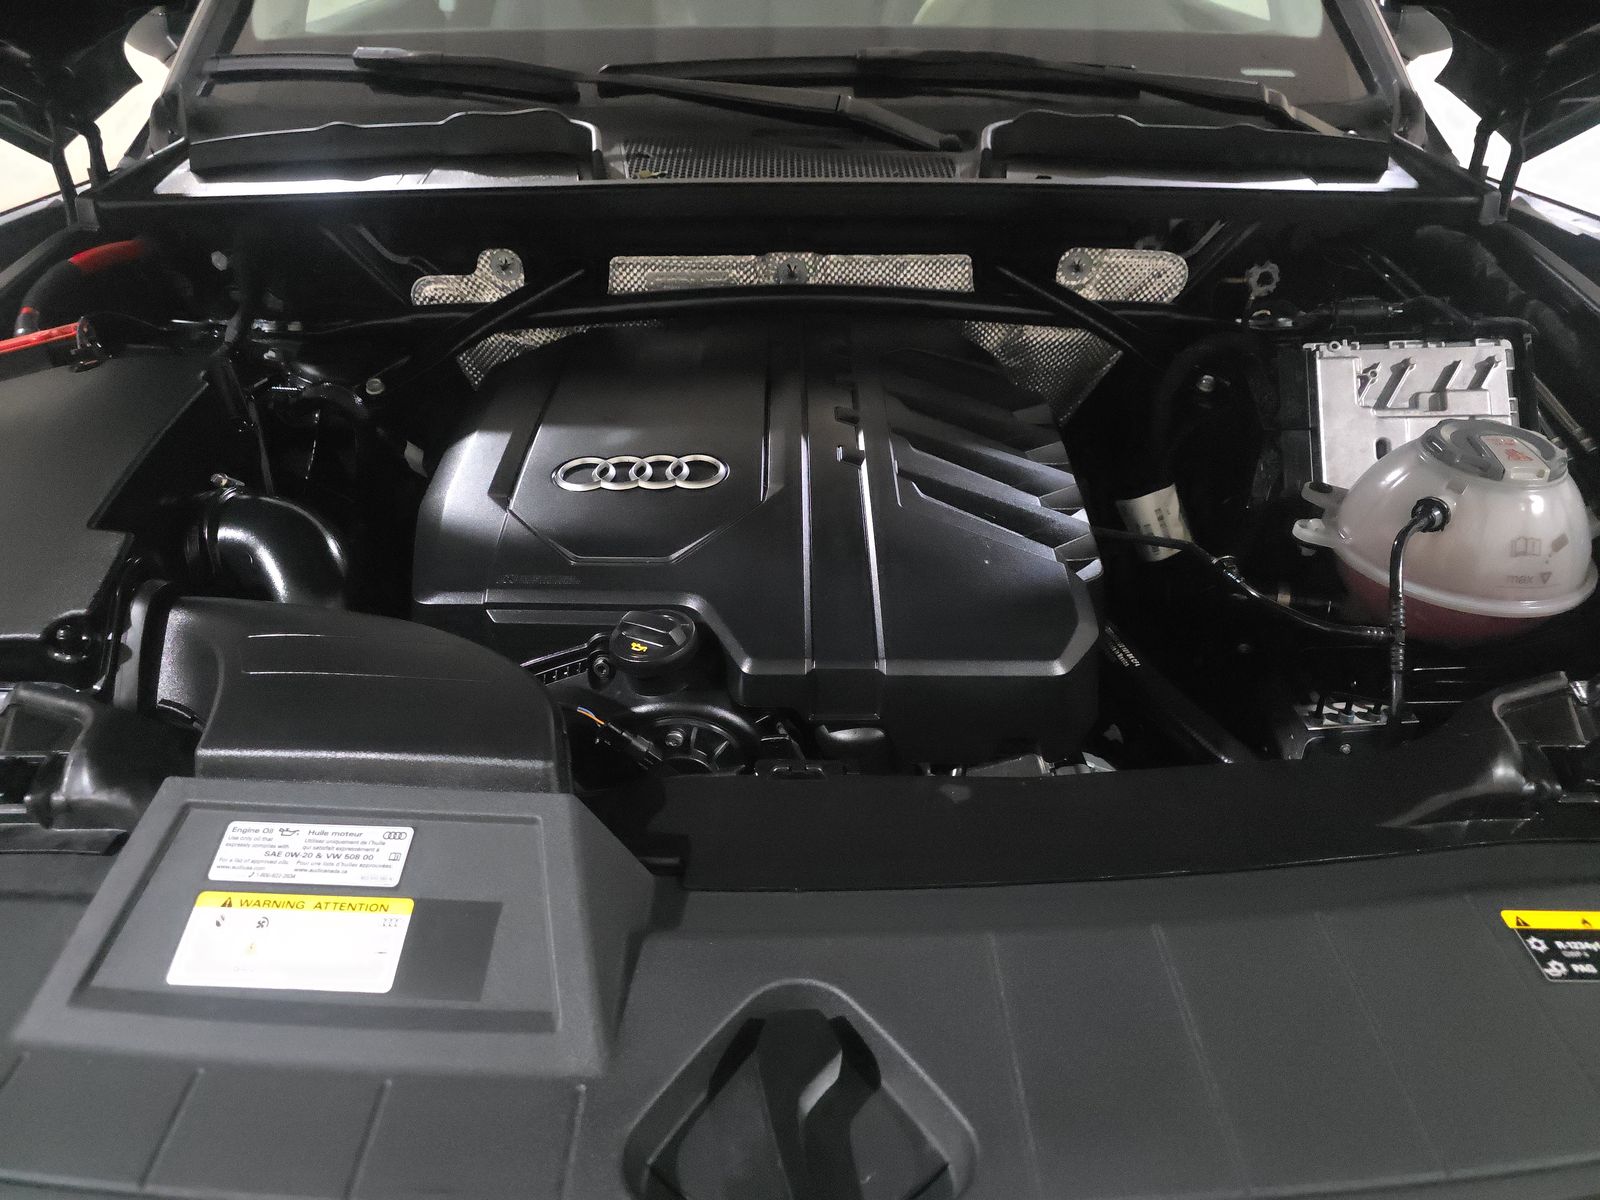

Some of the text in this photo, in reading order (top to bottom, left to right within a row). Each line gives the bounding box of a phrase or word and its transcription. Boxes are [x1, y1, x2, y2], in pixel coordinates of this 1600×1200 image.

[1507, 574, 1533, 585] max
[231, 826, 260, 834] Engine
[284, 851, 314, 859] 0W-20
[239, 899, 390, 912] WARNING ATTENTION
